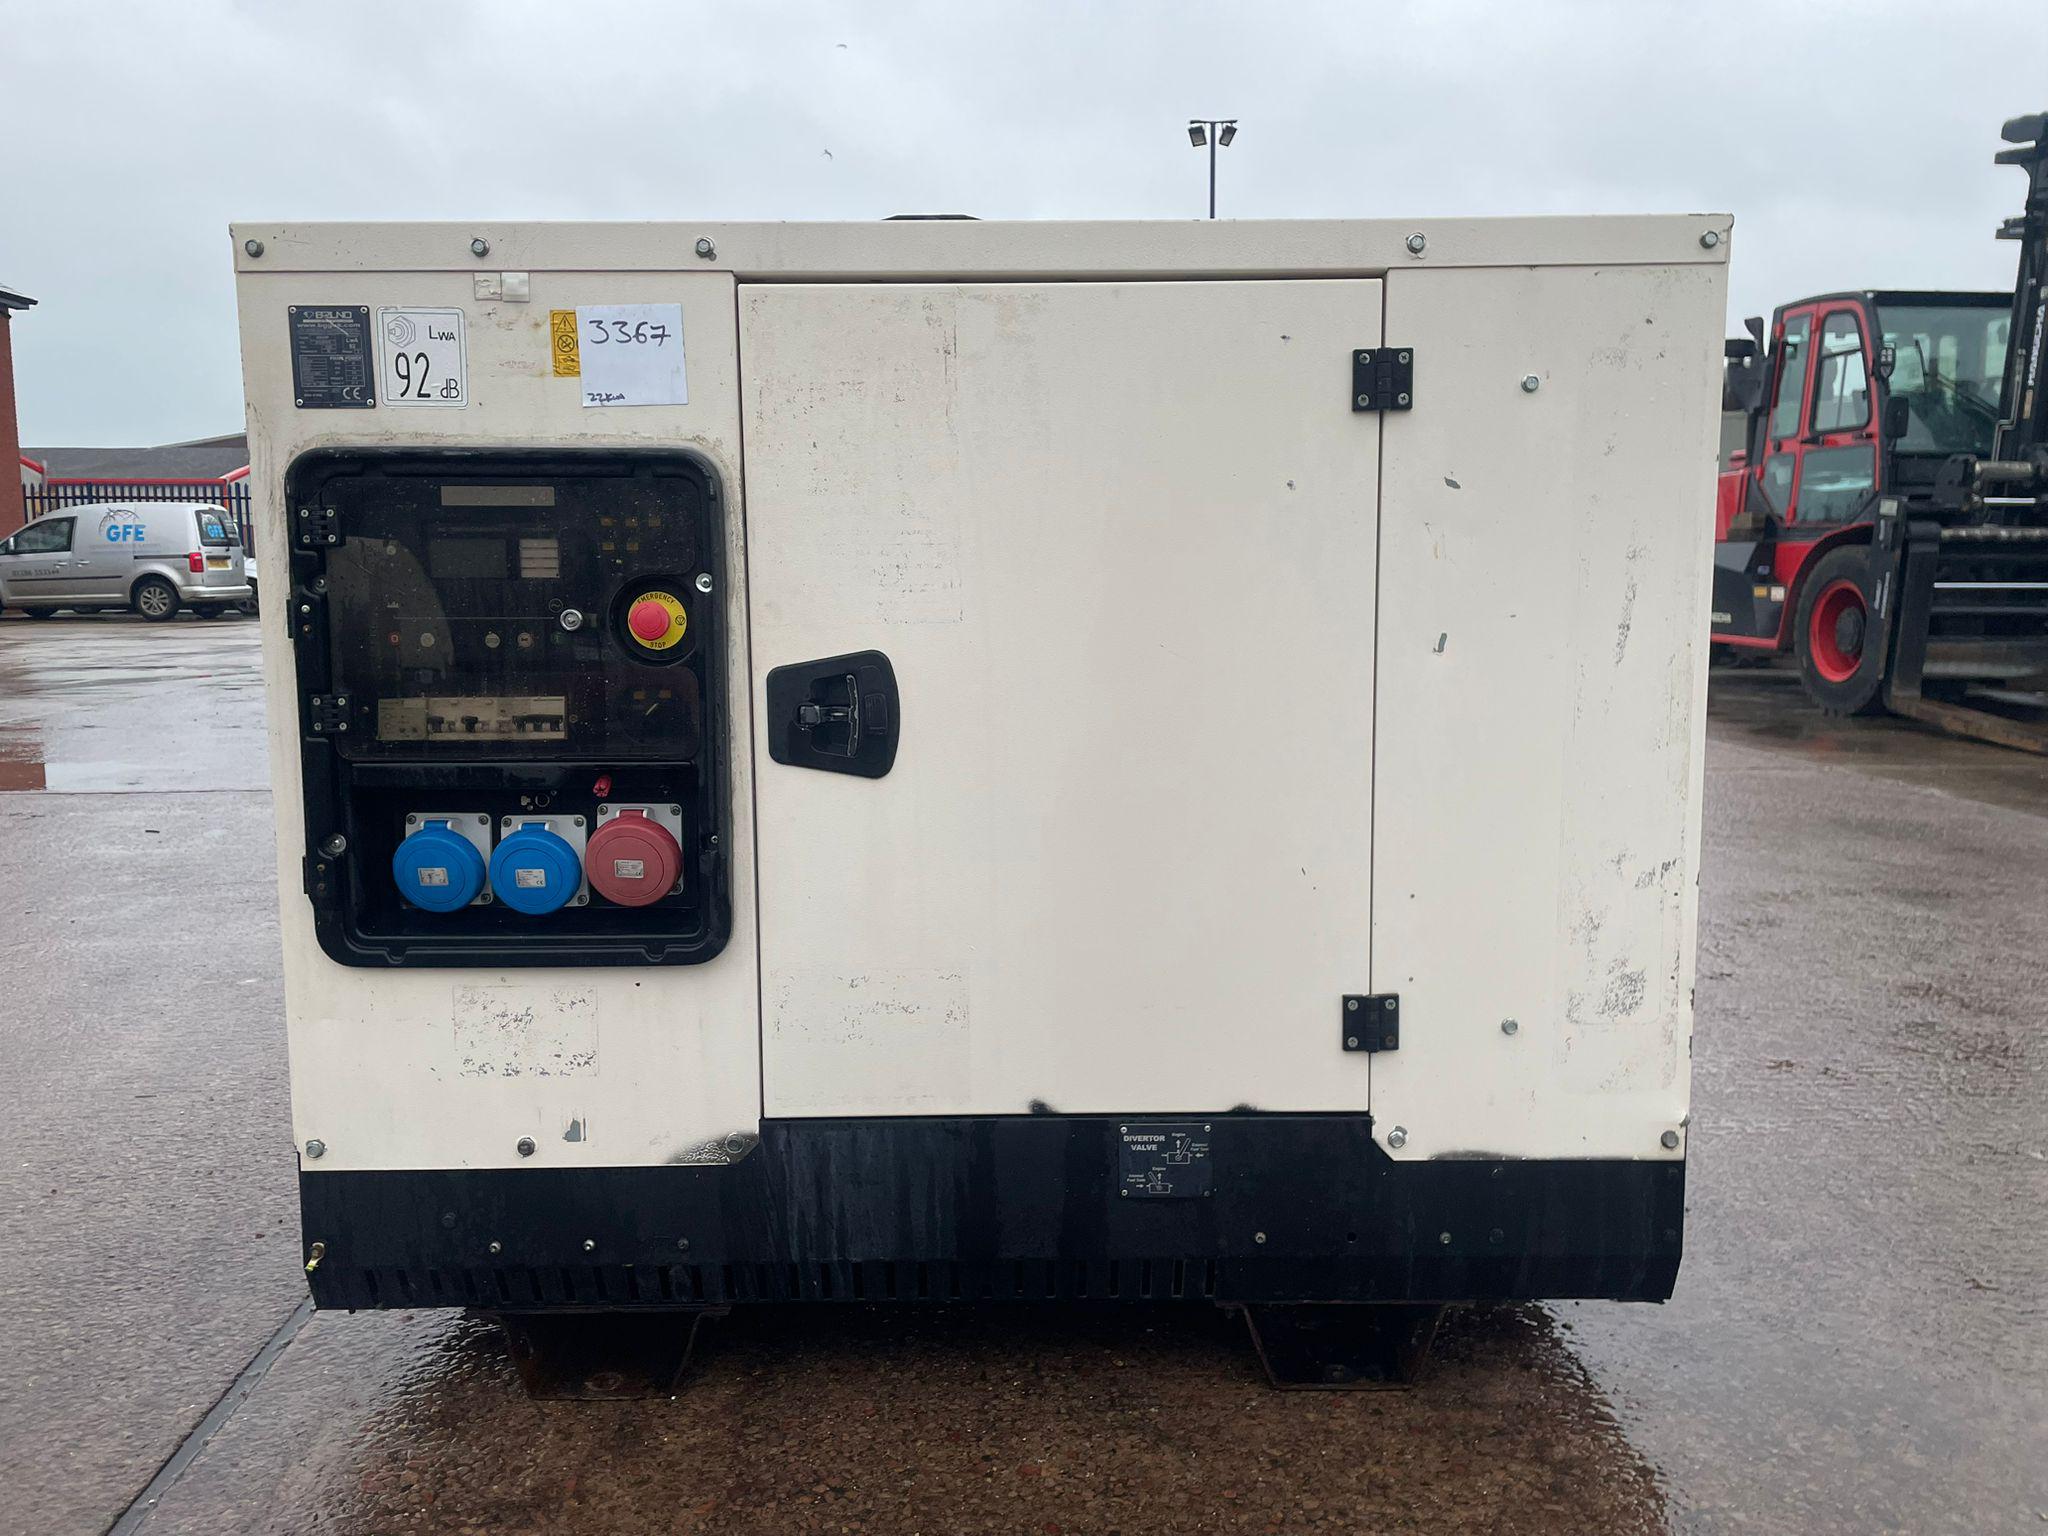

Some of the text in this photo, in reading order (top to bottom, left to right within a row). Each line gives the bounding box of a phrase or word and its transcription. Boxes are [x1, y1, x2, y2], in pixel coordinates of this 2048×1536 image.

[588, 320, 671, 347] 3367
[395, 352, 431, 398] 92
[440, 378, 460, 399] dB
[106, 524, 146, 542] GFE
[207, 524, 225, 539] GFE
[637, 592, 675, 604] EMERGENCY
